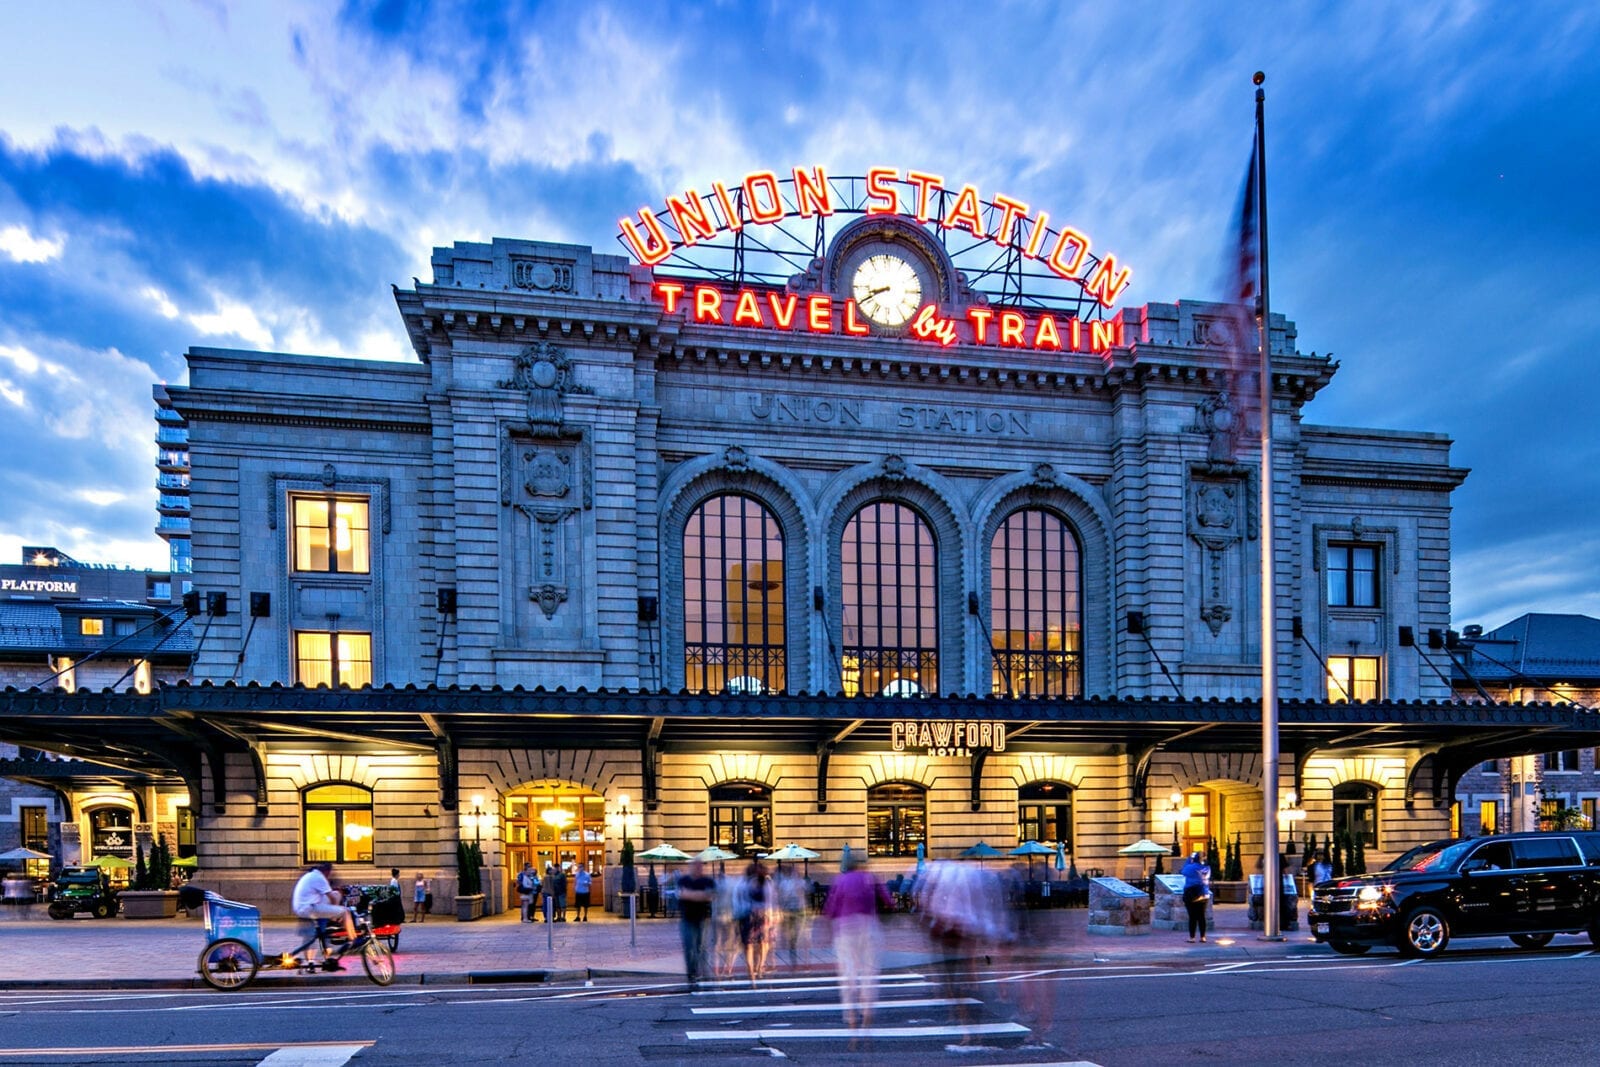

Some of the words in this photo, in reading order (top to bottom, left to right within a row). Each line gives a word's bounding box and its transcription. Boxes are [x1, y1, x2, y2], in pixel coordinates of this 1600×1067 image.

[618, 165, 835, 266] UNION
[866, 165, 1133, 308] STATION
[656, 282, 870, 335] TRAVEL
[912, 304, 957, 346] by
[967, 308, 1117, 353] TRAIN
[750, 397, 862, 425] UNION
[897, 405, 1031, 435] STATION
[1, 579, 76, 592] PLATFORM
[892, 722, 1005, 751] CRAWFORD
[927, 747, 973, 757] HOTEL
